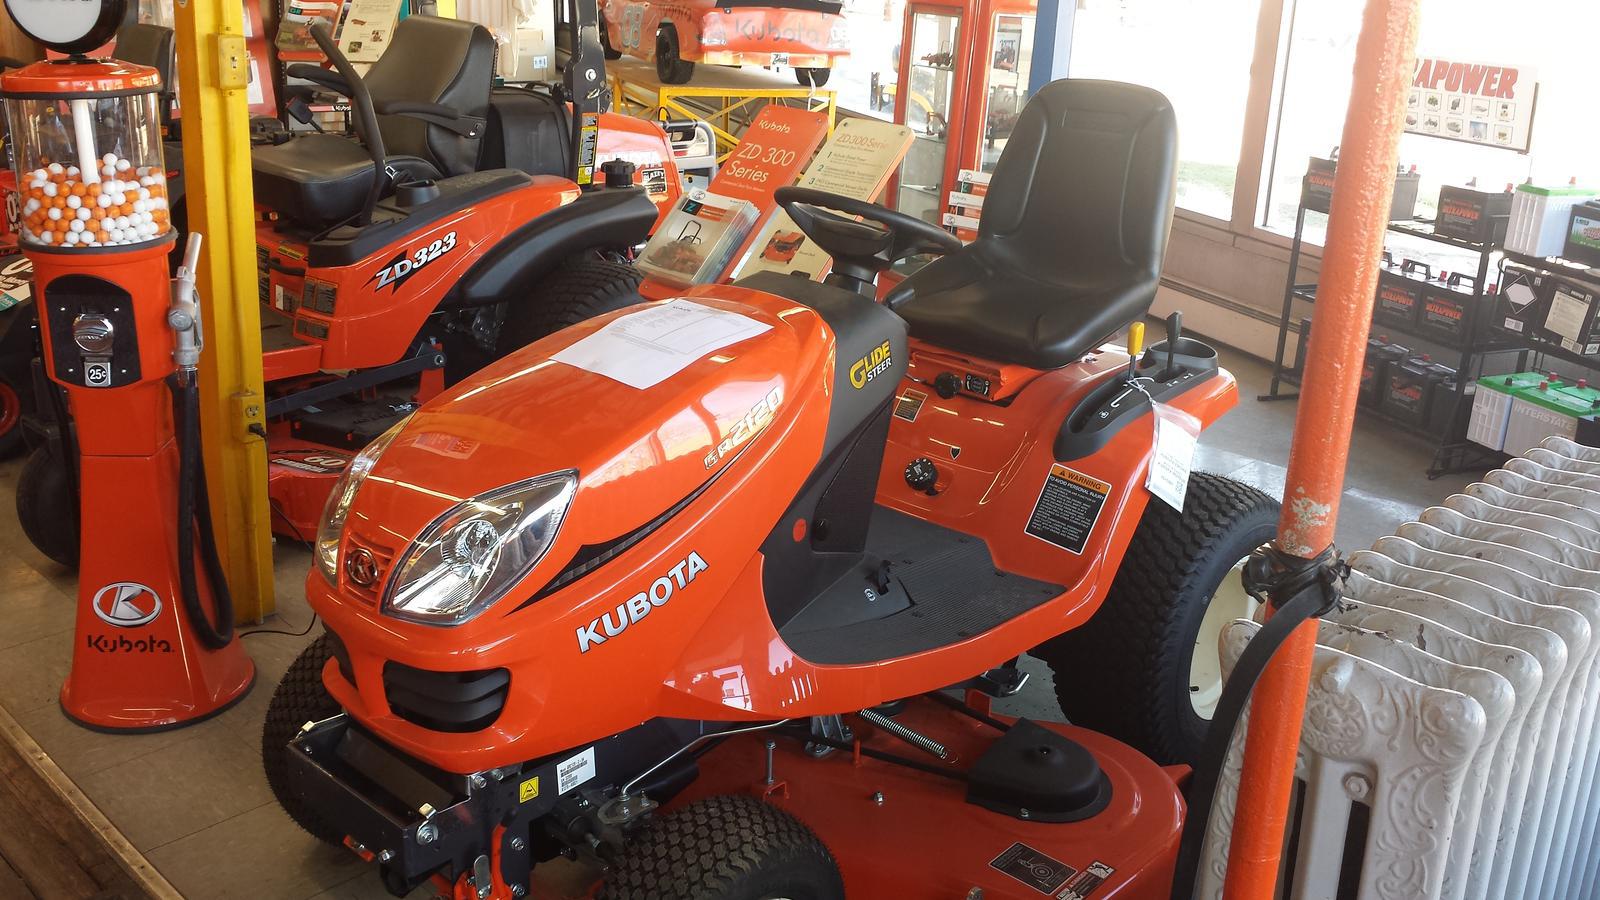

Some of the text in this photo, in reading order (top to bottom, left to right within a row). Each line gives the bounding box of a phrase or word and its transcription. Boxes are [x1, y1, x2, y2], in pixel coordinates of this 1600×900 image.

[735, 18, 820, 44] Kubota
[1412, 58, 1519, 99] APOWER
[759, 120, 791, 133] Kubota
[737, 143, 796, 167] ZD 300
[726, 160, 769, 182] Series
[817, 164, 824, 172] 2
[809, 177, 816, 185] 3
[375, 231, 457, 290] ZD323
[850, 340, 891, 389] GLIDE
[867, 357, 892, 382] STEER
[1514, 401, 1574, 431] INTERSTATE
[304, 456, 346, 466] 60
[1068, 472, 1102, 490] WARNING
[576, 551, 709, 654] KUBOTA
[88, 635, 171, 653] Kubota
